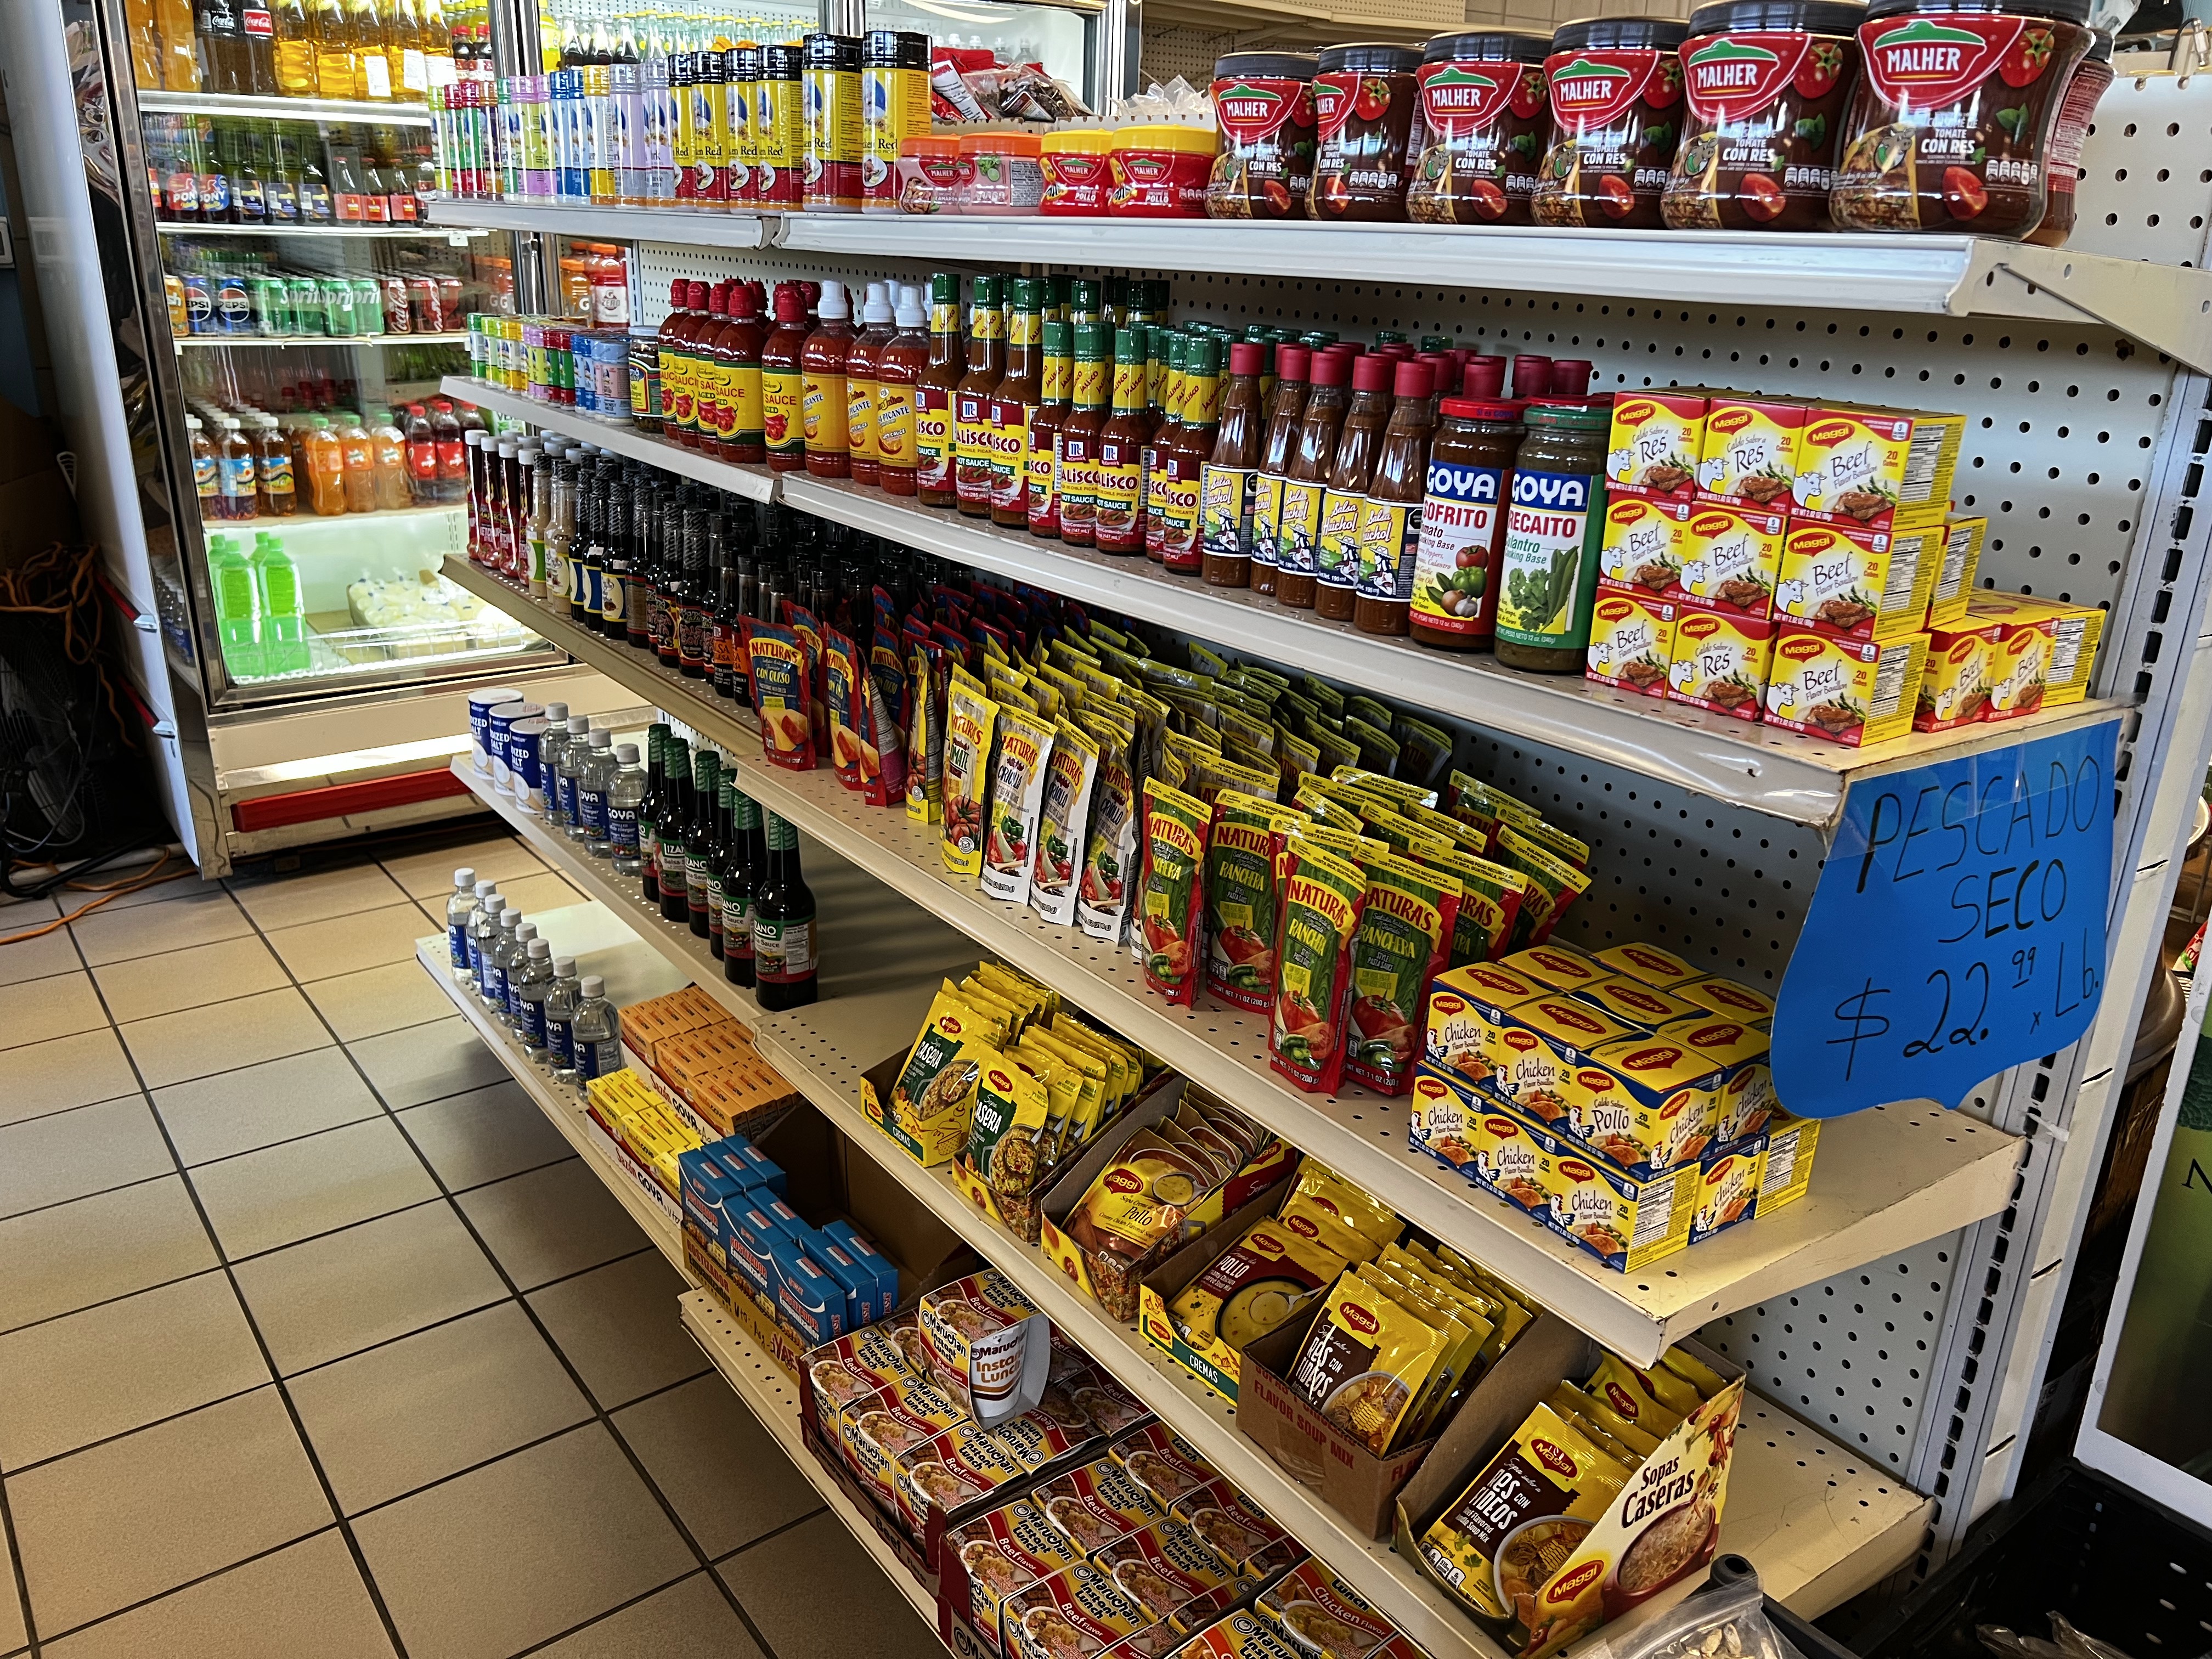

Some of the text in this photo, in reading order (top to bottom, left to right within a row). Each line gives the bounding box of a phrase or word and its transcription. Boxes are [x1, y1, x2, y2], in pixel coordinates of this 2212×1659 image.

[1887, 47, 1960, 73] MALHER
[1697, 64, 1757, 88] MALHER
[1432, 89, 1480, 107] MALHER
[1560, 80, 1611, 101] MALHER
[1226, 102, 1268, 117] MALHER
[1935, 128, 1966, 138] TOMATE
[741, 146, 758, 156] Red
[878, 138, 898, 150] Red
[1736, 139, 1766, 148] TOMATE
[1921, 140, 1974, 154] CON RES
[1723, 148, 1774, 162] CON RES
[930, 169, 953, 178] MALHER
[1060, 166, 1088, 176] MALHER
[1133, 167, 1158, 177] MALHER
[1146, 195, 1169, 203] POLLO
[219, 301, 249, 311] PEPSI
[280, 287, 319, 306] Sprit
[579, 297, 590, 309] G
[715, 388, 745, 398] SAUCE
[765, 396, 797, 405] SAUCE
[883, 406, 910, 421] PICANTE
[1621, 407, 1651, 421] Maggi
[1715, 415, 1748, 428] Maggi
[1682, 427, 1691, 436] 20
[1813, 426, 1849, 442] Maggi
[1640, 437, 1667, 462] Res
[1735, 445, 1763, 473] Res
[1831, 441, 1872, 476] Beef
[1887, 450, 1898, 460] 20
[1210, 476, 1231, 490] Salsa
[1426, 465, 1494, 500] GOYA
[1513, 473, 1583, 506] GOYA
[1104, 500, 1126, 509] SAUCE
[1286, 489, 1308, 505] Salsa
[1331, 501, 1357, 517] Salsa
[1424, 500, 1487, 529] SOFRITO
[1613, 507, 1643, 520] Maggi
[1323, 514, 1357, 537] Huichol
[1508, 513, 1576, 538] RECAITO
[1696, 519, 1728, 533] Maggi
[1438, 539, 1455, 551] Base
[1629, 521, 1661, 551] Beef
[1794, 535, 1829, 550] Maggi
[1713, 533, 1749, 566] Beef
[1526, 555, 1547, 565] Base
[1813, 551, 1853, 585] Beef
[1600, 604, 1629, 617] Maggi
[1616, 619, 1647, 649] Beef
[1684, 622, 1716, 634] Maggi
[1747, 647, 1756, 656] 20
[1784, 643, 1820, 656] Maggi
[1703, 653, 1730, 677] Res
[1803, 660, 1842, 689] Beef
[757, 668, 790, 684] CON QUESO
[608, 808, 635, 820] GOYA
[1857, 755, 2100, 893] PESCADO
[1220, 861, 1264, 891] RANCHERA
[1938, 859, 2067, 943] SECO
[761, 940, 780, 948] Sauce
[1360, 924, 1415, 958] RANCHERA
[1436, 1001, 1460, 1009] Maggi
[1445, 1020, 1481, 1038] Chicken
[1487, 1030, 1495, 1039] 20
[1507, 1036, 1534, 1045] Maggi
[1516, 1058, 1555, 1077] Chicken
[1629, 1048, 1675, 1068] Maggi
[990, 1074, 1011, 1089] Maggi
[1420, 1084, 1443, 1093] Maggi
[1582, 1076, 1610, 1086] Maggi
[672, 1097, 696, 1129] GOYA
[1429, 1105, 1463, 1124] Chicken
[1592, 1110, 1629, 1132] Pollo
[892, 1126, 911, 1147] CREMAS
[1488, 1124, 1514, 1133] Maggi
[1497, 1146, 1535, 1165] Chicken
[1563, 1166, 1590, 1177] Maggi
[637, 1170, 663, 1206] GOYA
[1572, 1190, 1612, 1210] Chicken
[1126, 1206, 1153, 1225] Pollo
[1290, 1218, 1317, 1236] Maggi
[1254, 1235, 1283, 1253] Maggi
[1216, 1256, 1250, 1278] POLLO
[970, 1297, 986, 1311] Beef
[983, 1289, 1005, 1309] Lunch
[988, 1283, 1019, 1308] Instant
[997, 1277, 1037, 1313] Maruchan
[1341, 1305, 1379, 1333] Maggi
[930, 1314, 967, 1357] Maruchan
[932, 1328, 956, 1358] Instant
[934, 1341, 953, 1364] Lunch
[1189, 1354, 1218, 1383] CREMAS
[904, 1396, 927, 1418] Lunch
[908, 1389, 939, 1415] Instant
[915, 1383, 959, 1420] Maruchan
[891, 1406, 926, 1430] Beef Flavor
[1254, 1380, 1353, 1469] FLAVOR SOUP MIX
[959, 1447, 983, 1470] Lunch
[964, 1440, 995, 1469] Instant
[973, 1432, 1015, 1475] Maruchan
[1536, 1442, 1572, 1474] Maggi
[946, 1458, 980, 1485] Beef Flavor
[1641, 1457, 1679, 1490] Sopas
[1514, 1492, 1531, 1509] CON
[1621, 1470, 1695, 1529] Caseras
[1084, 1495, 1121, 1526] Beef Flavor
[1471, 1511, 1494, 1533] Flavored
[1013, 1527, 1039, 1554] Lunch
[1018, 1520, 1051, 1553] Instant
[1029, 1512, 1073, 1561] Maruchan
[1554, 1567, 1599, 1597] Maggi
